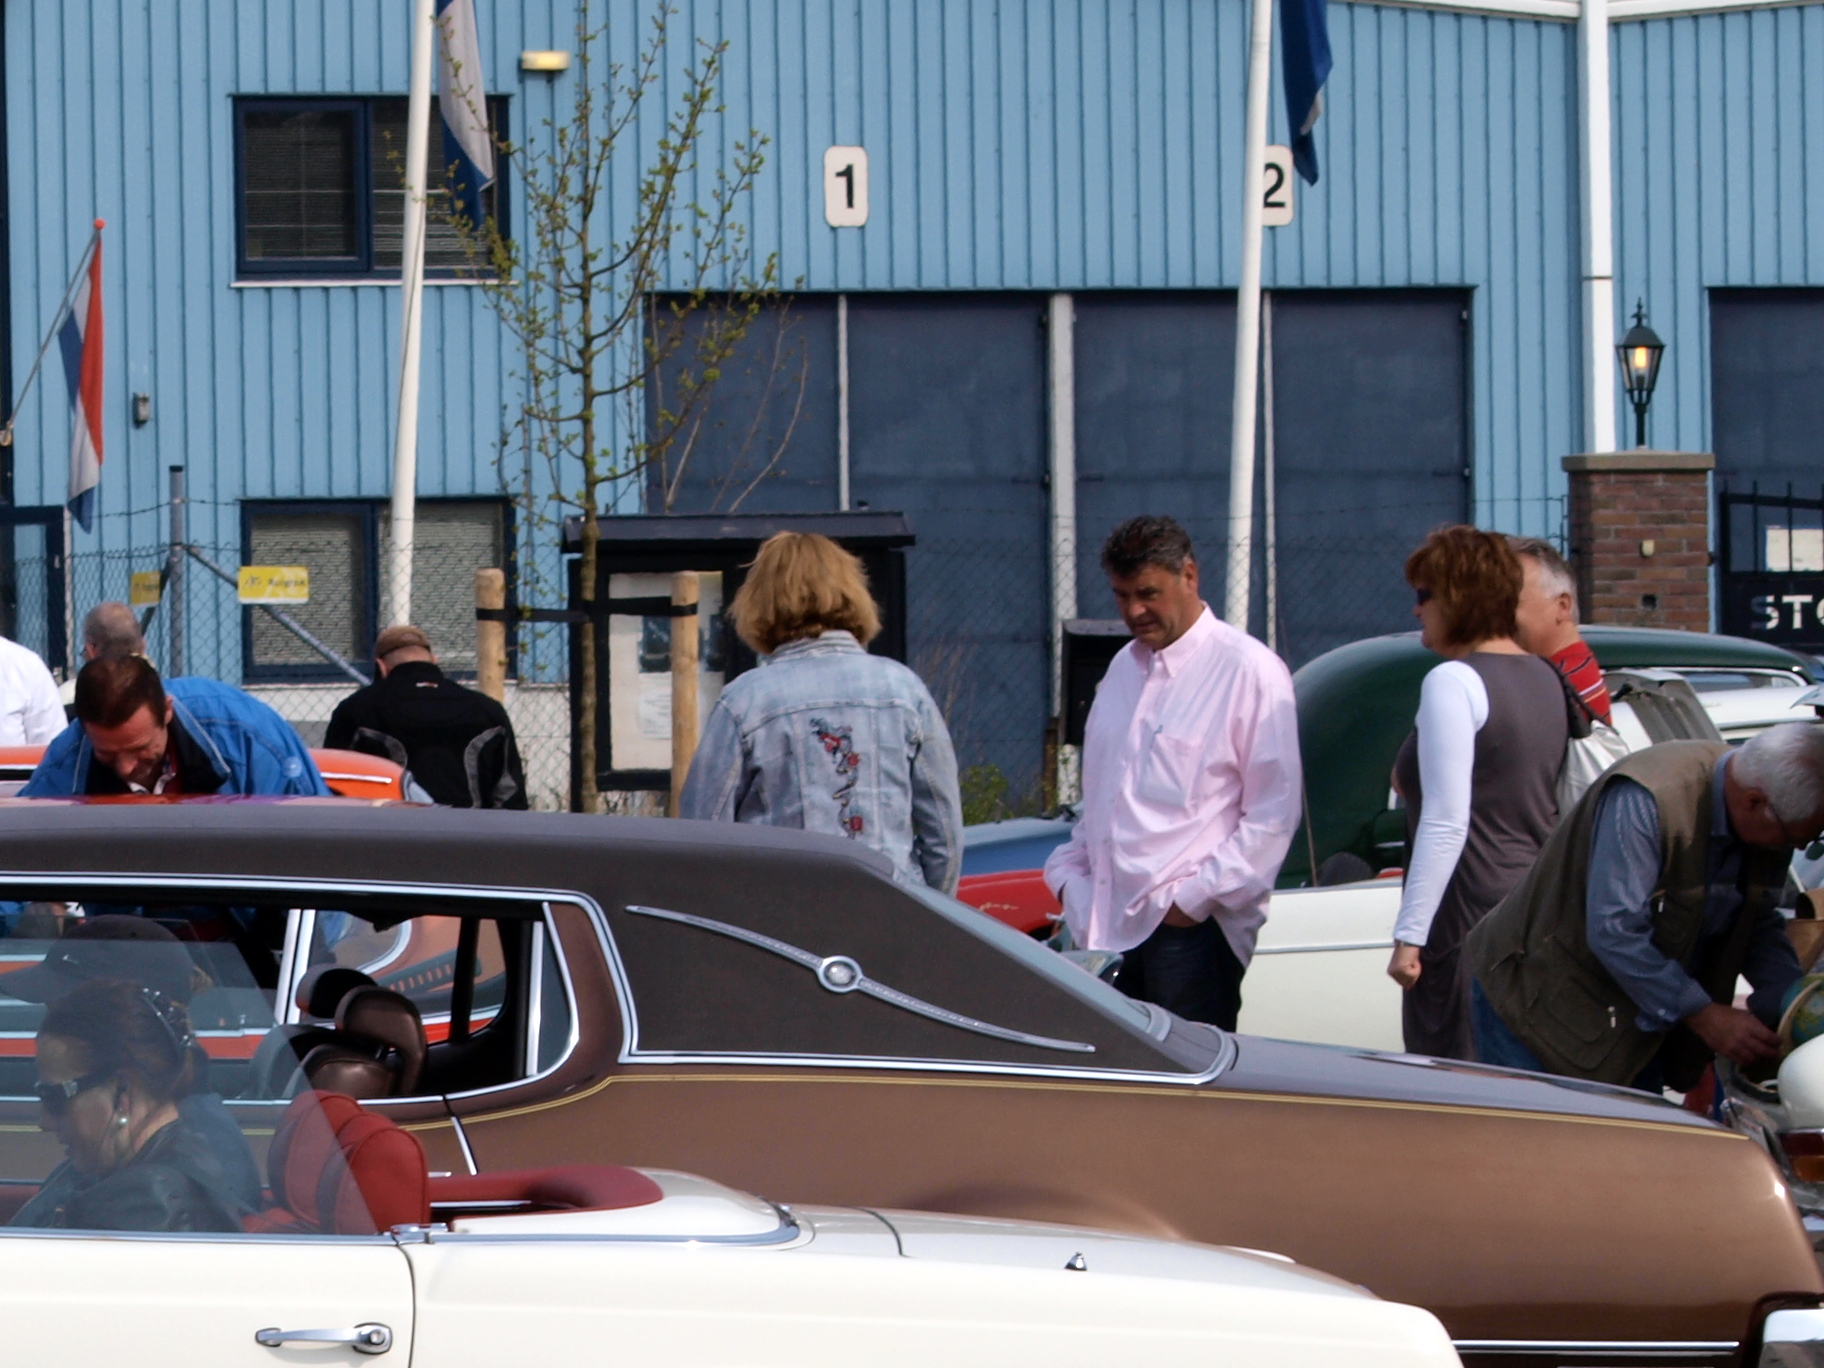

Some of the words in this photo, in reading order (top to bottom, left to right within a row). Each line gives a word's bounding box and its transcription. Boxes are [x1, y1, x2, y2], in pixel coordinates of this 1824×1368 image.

[835, 163, 854, 208] 1
[1263, 161, 1286, 208] 2
[1751, 594, 1824, 630] ST
